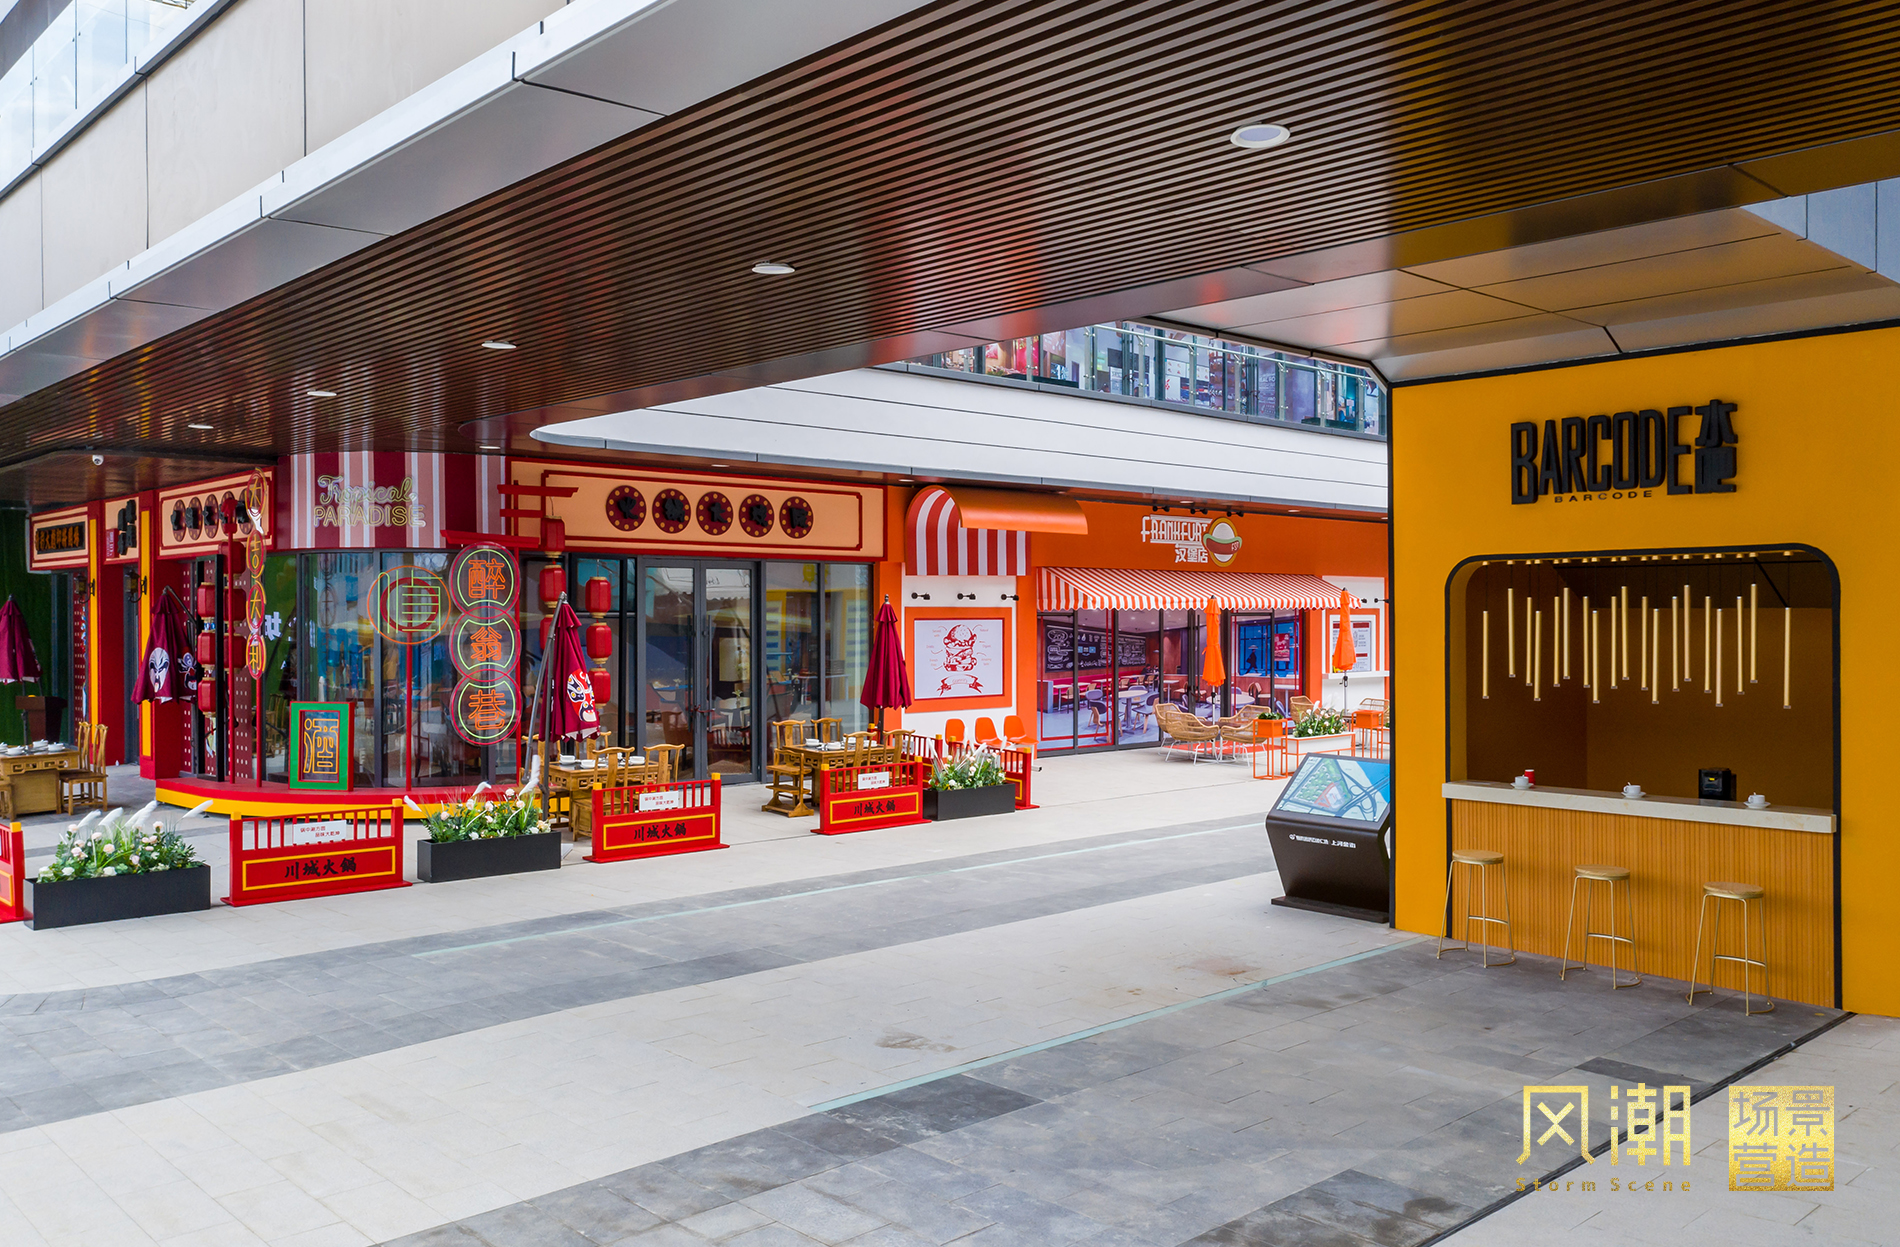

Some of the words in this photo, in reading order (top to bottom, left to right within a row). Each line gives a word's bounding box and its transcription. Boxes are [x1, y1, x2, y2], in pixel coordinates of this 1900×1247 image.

[1511, 406, 1692, 504] BARCODE
[317, 475, 417, 513] Tropical
[1554, 490, 1652, 503] BARCODE
[314, 505, 426, 527] PARADISE
[1141, 516, 1208, 542] FRANKFURT
[1175, 548, 1208, 563] 汉堡店
[466, 557, 508, 732] 醉翁巷
[633, 822, 687, 841] 川城火鍋
[285, 857, 357, 879] 川城火鍋
